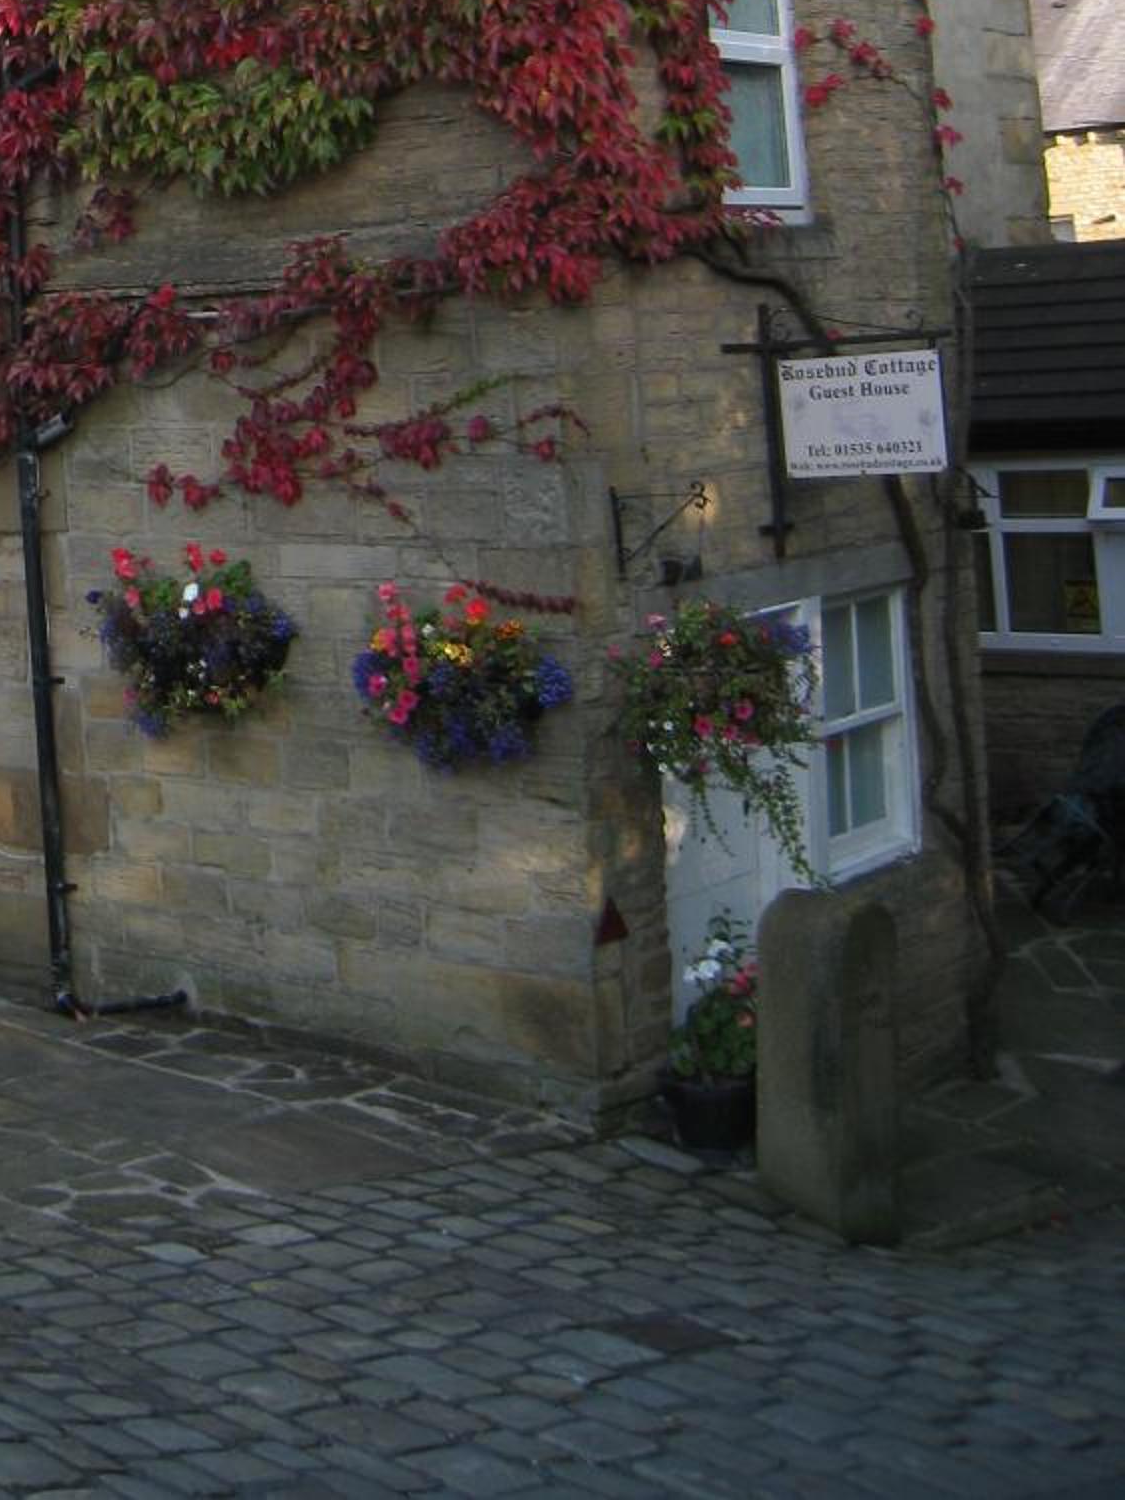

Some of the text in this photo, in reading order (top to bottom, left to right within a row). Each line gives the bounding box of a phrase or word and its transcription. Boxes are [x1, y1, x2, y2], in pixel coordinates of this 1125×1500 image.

[781, 358, 937, 381] Rosebud Cottage
[809, 382, 910, 400] Guest House
[807, 440, 922, 457] Tel: 01535 640321
